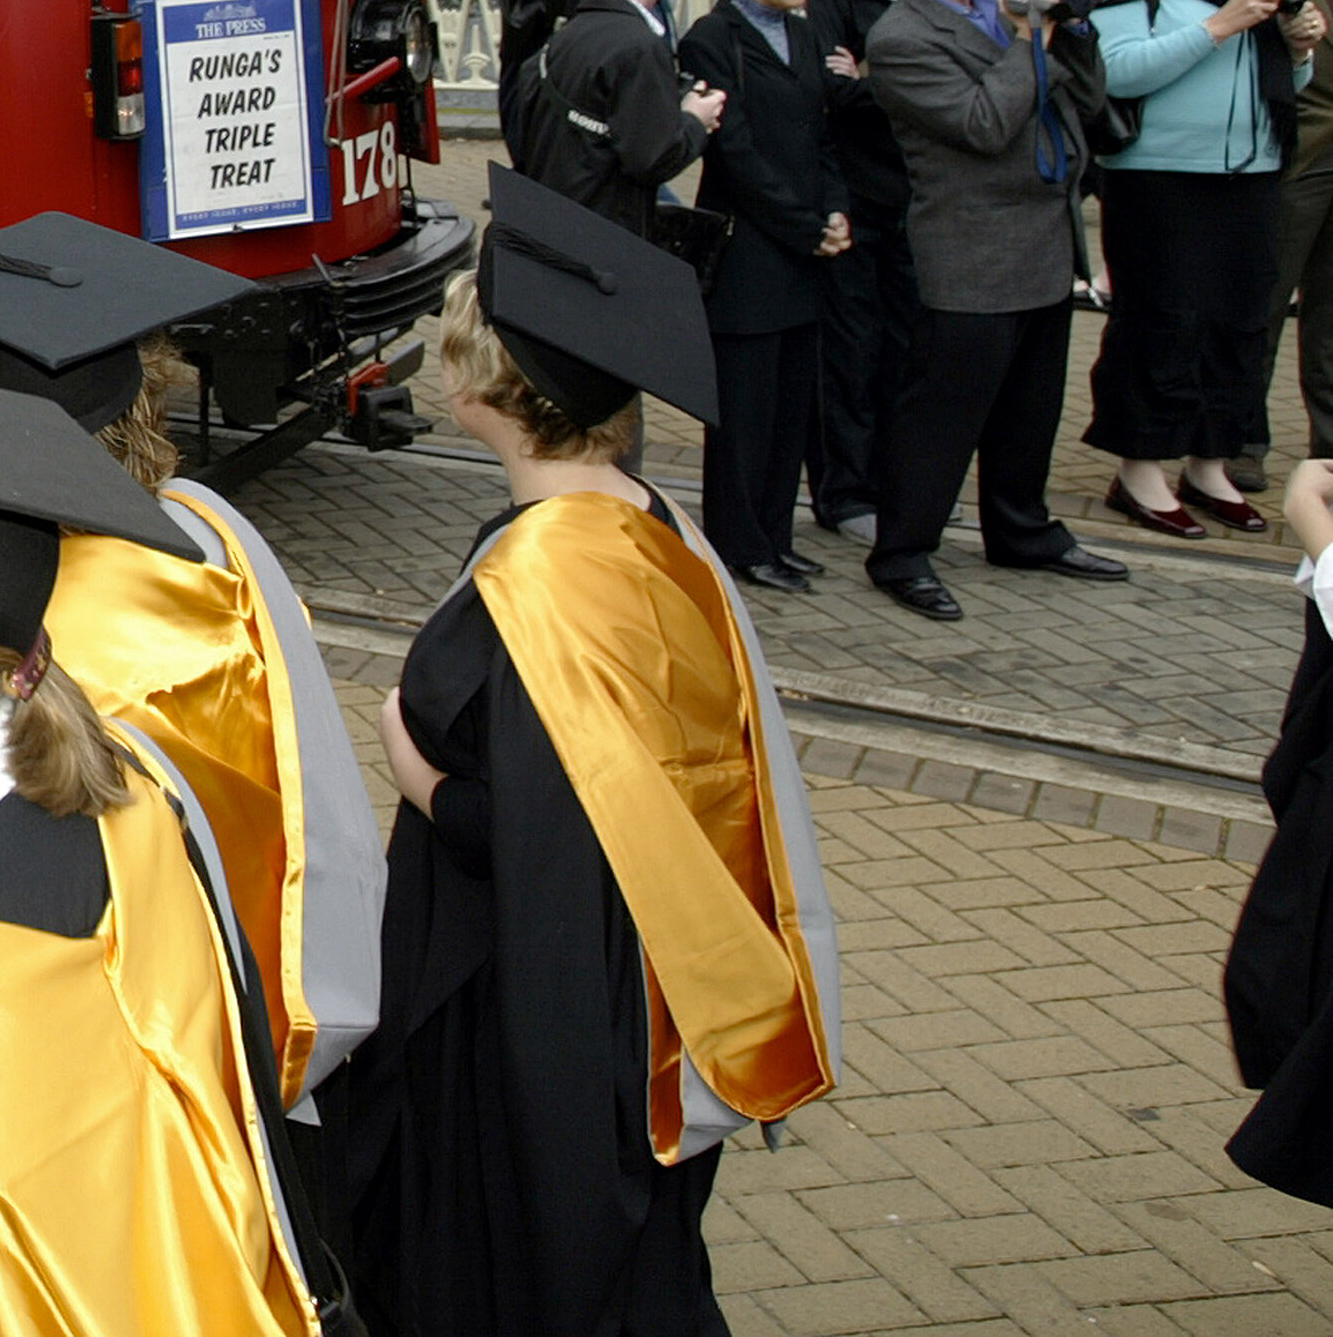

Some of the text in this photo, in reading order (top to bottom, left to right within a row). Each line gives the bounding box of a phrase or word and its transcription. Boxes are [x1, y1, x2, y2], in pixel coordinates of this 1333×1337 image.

[195, 17, 266, 39] THE PRESS
[189, 48, 282, 83] RUNGA'S
[197, 87, 276, 119] AWARD
[204, 123, 276, 154] TRIPLE
[210, 158, 275, 189] TREAT
[341, 120, 398, 207] 178
